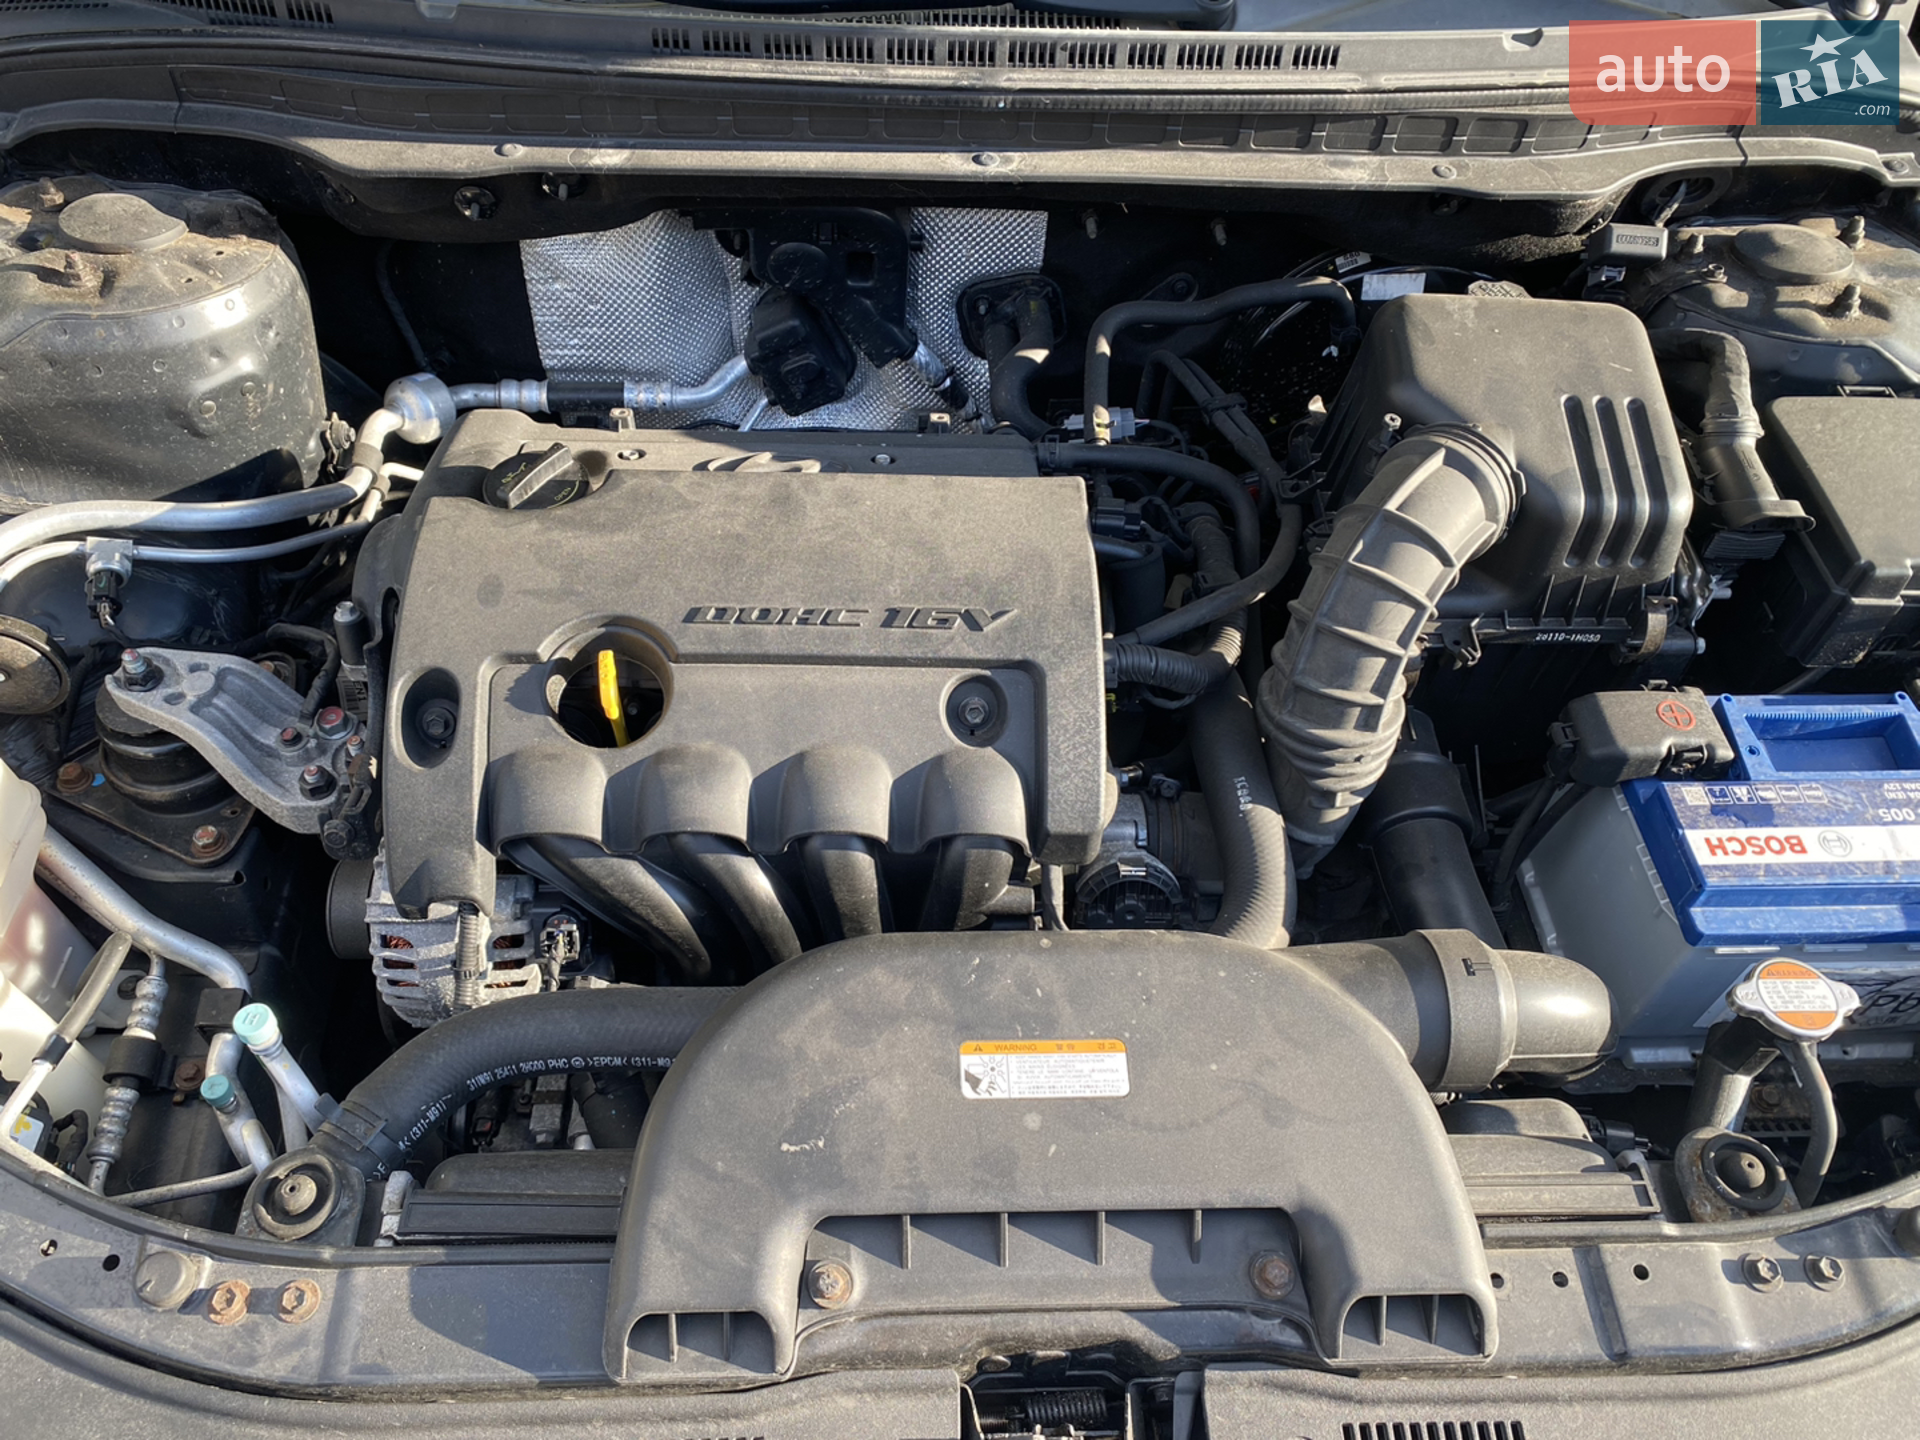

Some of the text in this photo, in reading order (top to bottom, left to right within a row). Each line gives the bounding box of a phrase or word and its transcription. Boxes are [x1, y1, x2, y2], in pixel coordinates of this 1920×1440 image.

[554, 487, 572, 501] OPEN
[681, 604, 1018, 632] DOHC 16V
[1879, 808, 1916, 821] 005
[1704, 835, 1808, 857] BOSCH
[994, 1043, 1038, 1052] WARNING
[547, 1058, 569, 1069] PHC
